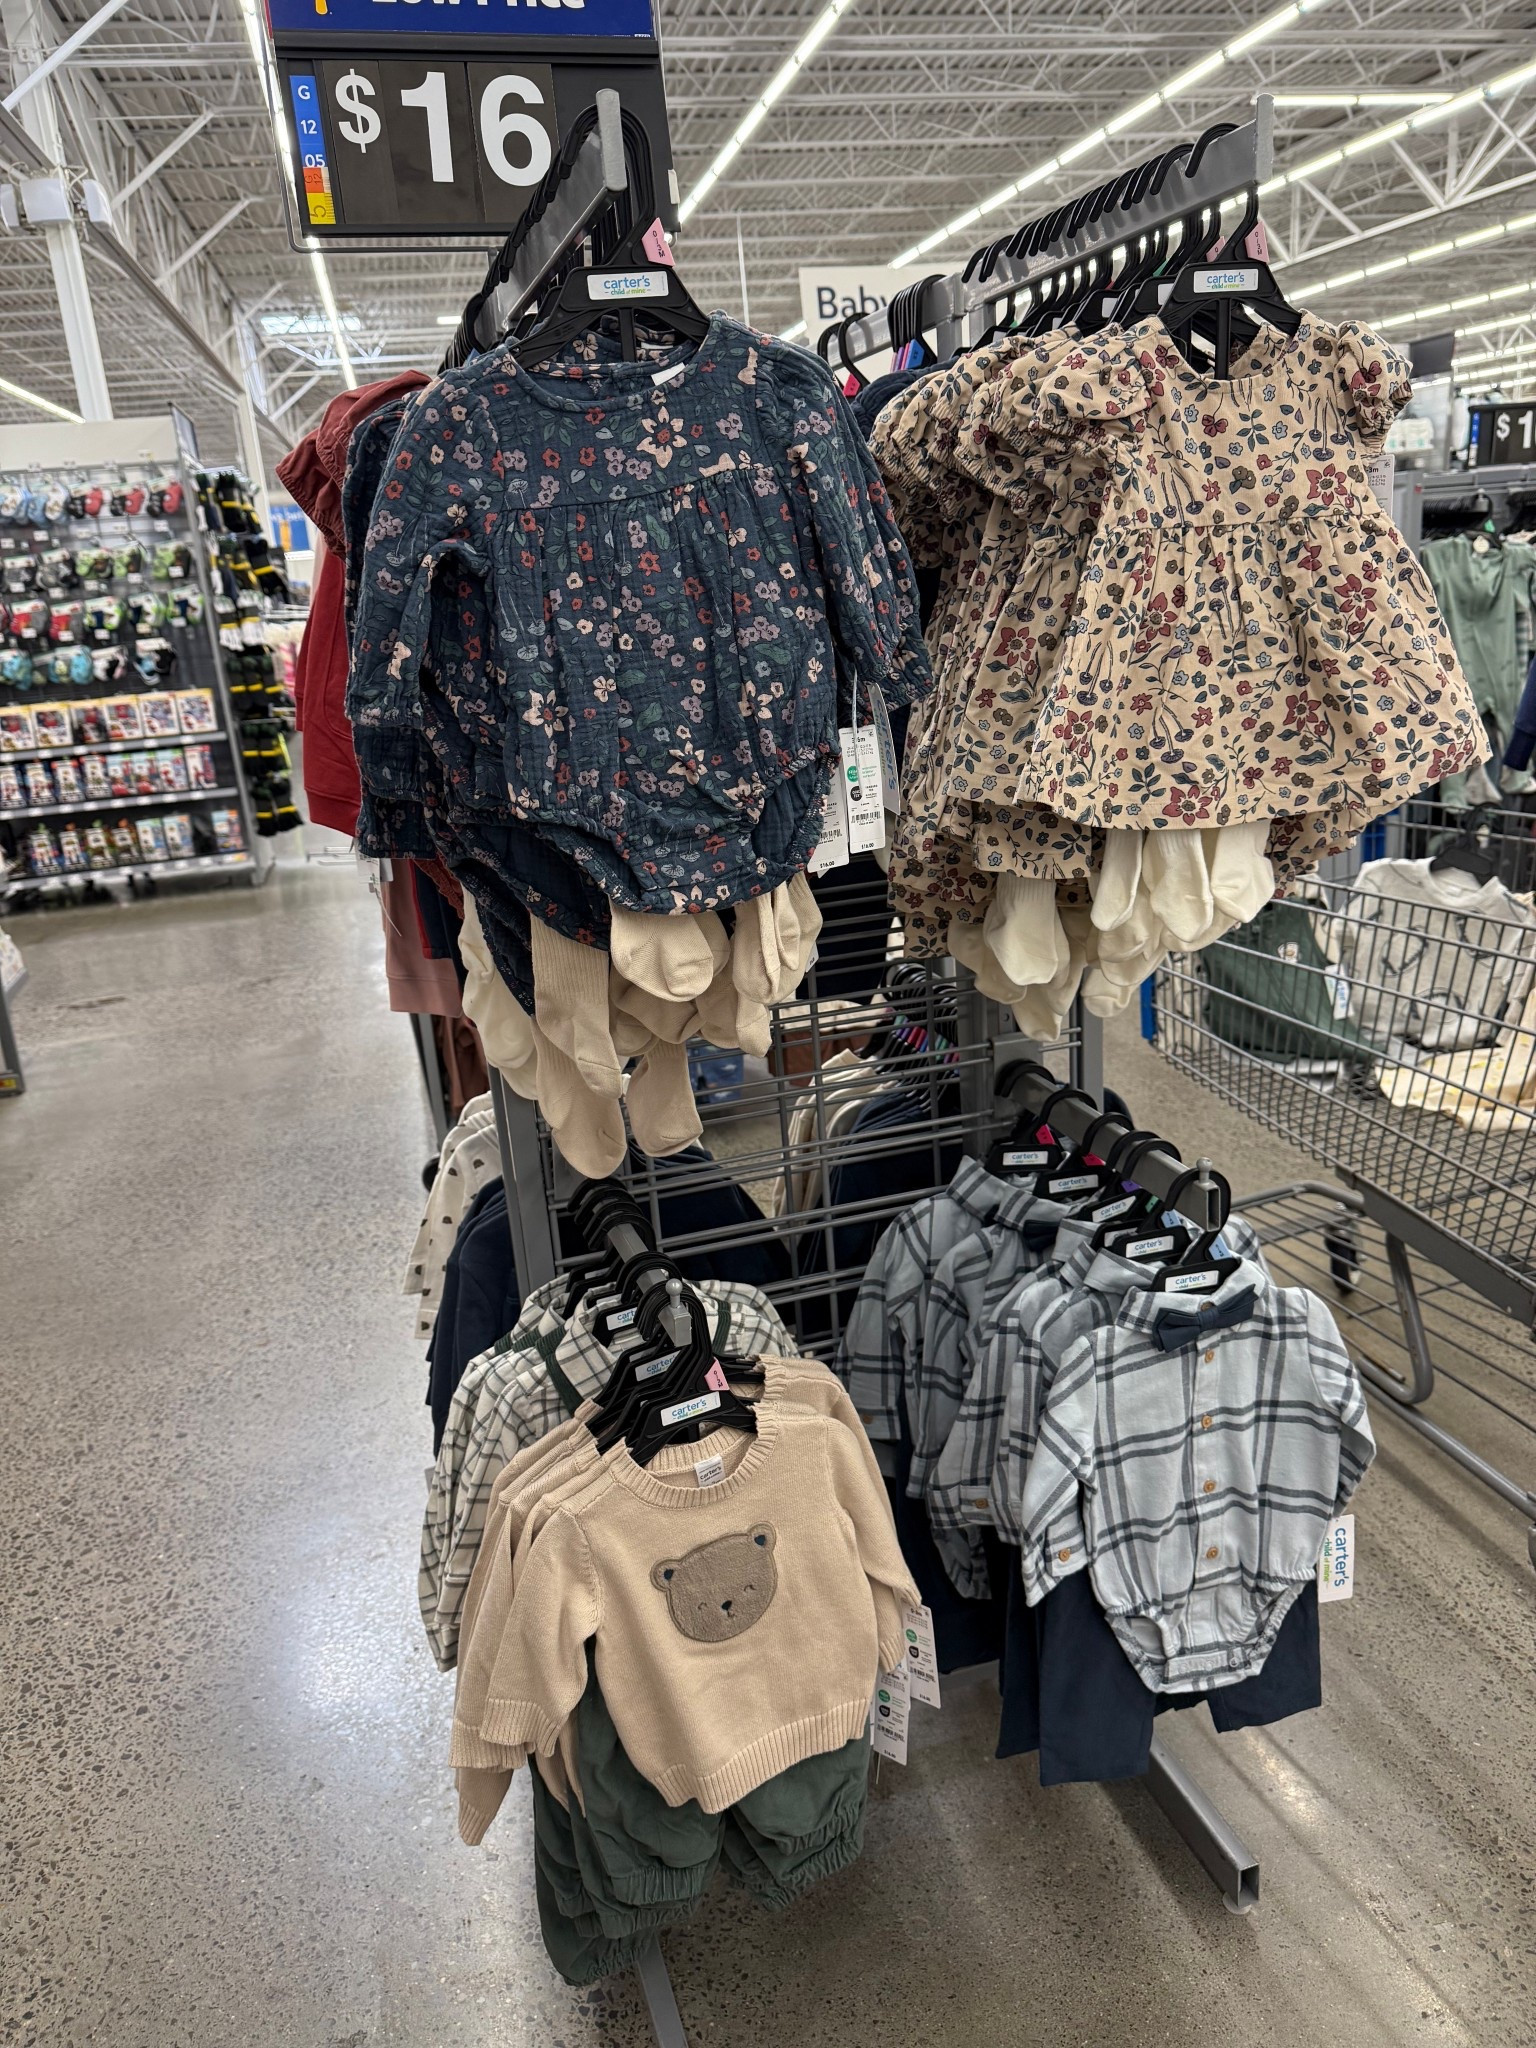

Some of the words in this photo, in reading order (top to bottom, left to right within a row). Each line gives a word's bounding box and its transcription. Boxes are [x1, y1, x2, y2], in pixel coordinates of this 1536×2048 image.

[297, 85, 311, 100] G
[300, 119, 318, 135] 12
[335, 68, 552, 187] $16
[304, 154, 326, 168] 05
[603, 274, 651, 290] carter's
[1206, 272, 1245, 284] carter's
[610, 288, 626, 296] child
[1496, 410, 1536, 449] $1
[1011, 1152, 1039, 1161] carter's
[1057, 1177, 1088, 1187] carter's
[1100, 1201, 1127, 1216] carter's
[1134, 1238, 1163, 1251] carter's
[1175, 1273, 1207, 1285] carter's
[646, 1355, 675, 1372] carter'
[671, 1398, 707, 1417] carter's
[699, 1466, 722, 1480] carter's
[1333, 1527, 1350, 1587] carter's
